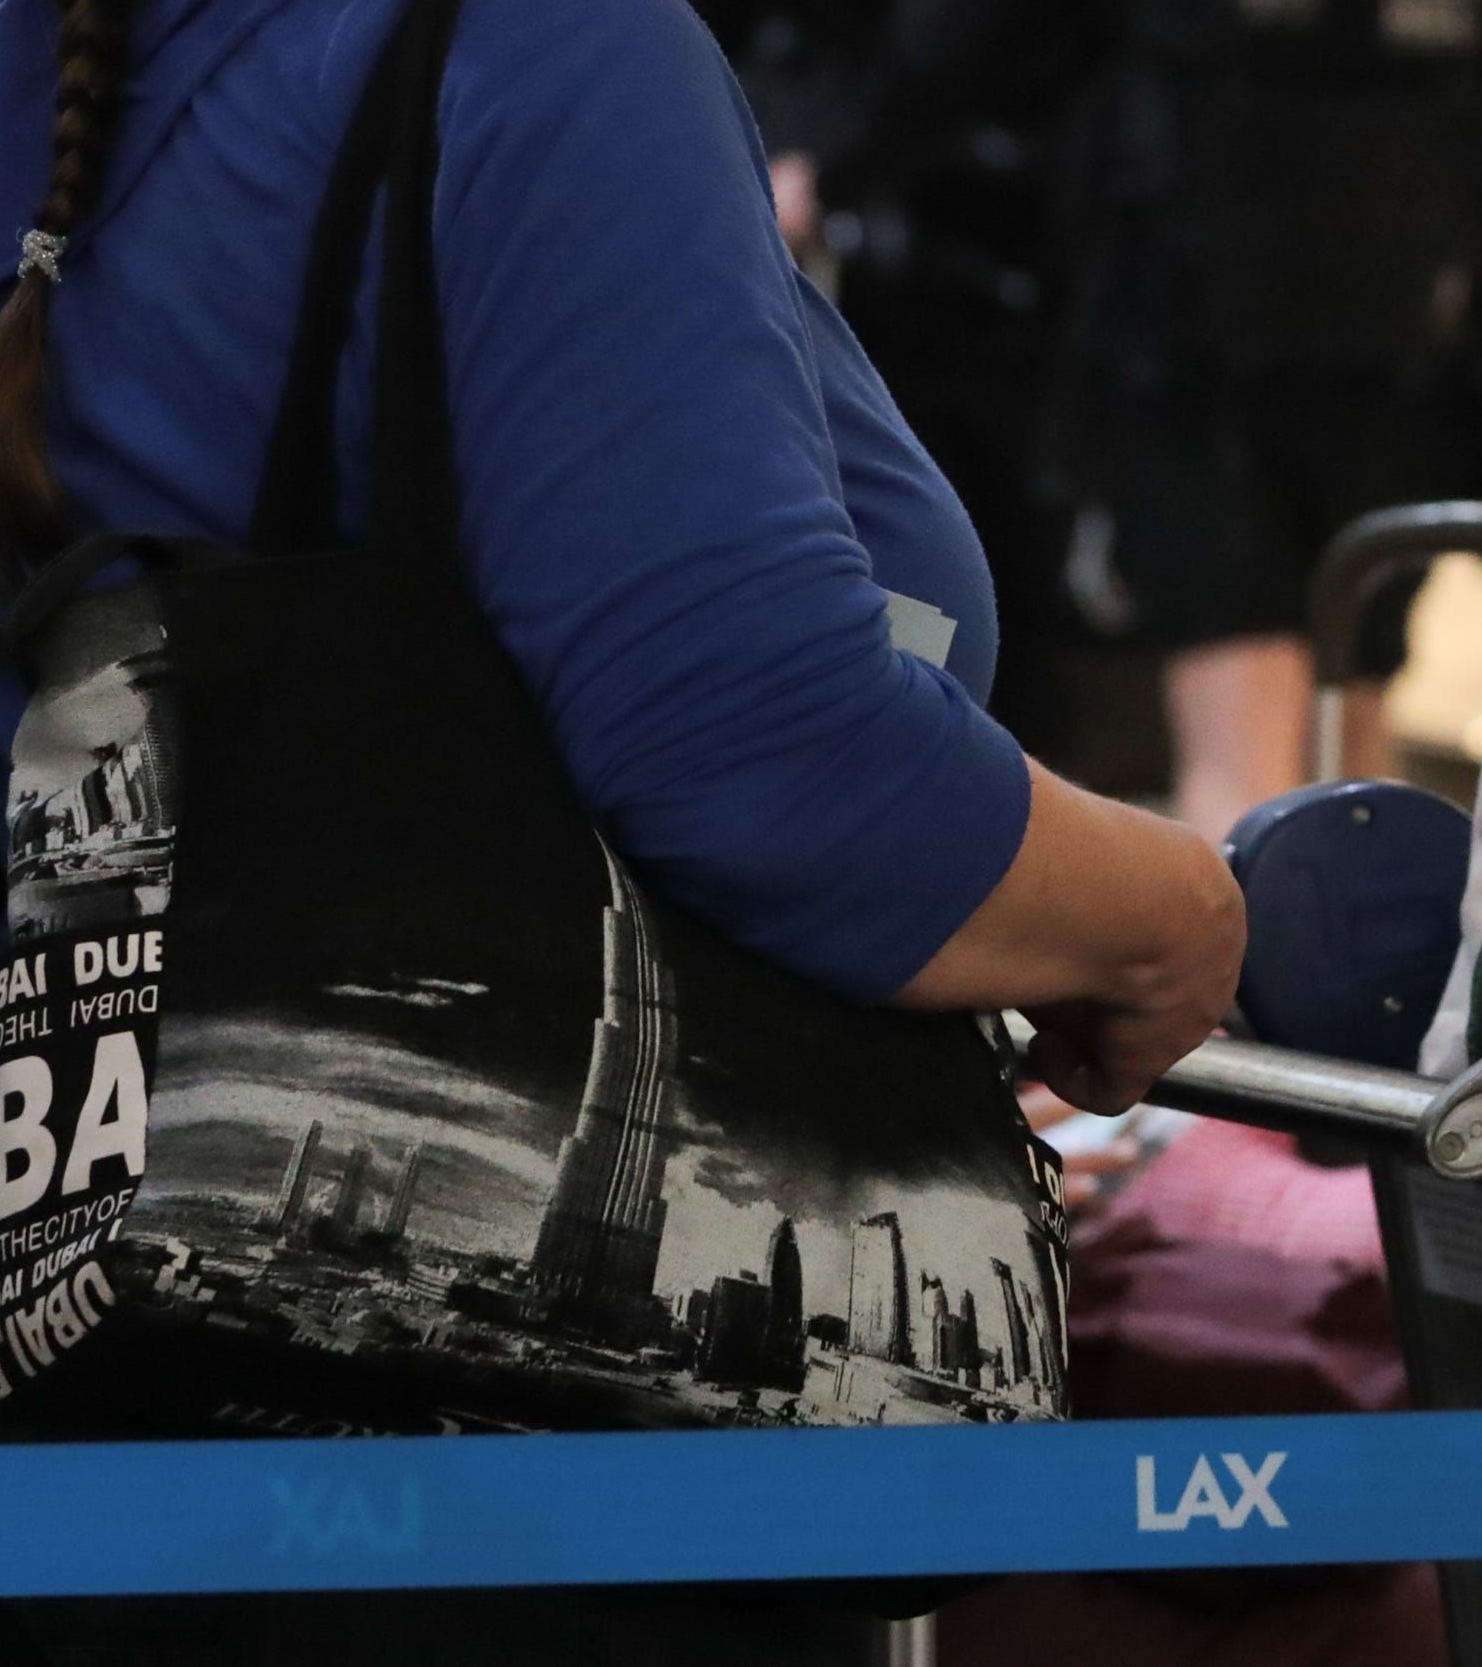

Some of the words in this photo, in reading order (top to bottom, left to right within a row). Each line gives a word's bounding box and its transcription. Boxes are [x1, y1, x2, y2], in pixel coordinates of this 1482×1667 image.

[70, 984, 159, 1029] DUBAI
[31, 1227, 102, 1289] DUBAI
[1137, 1453, 1288, 1531] LAX
